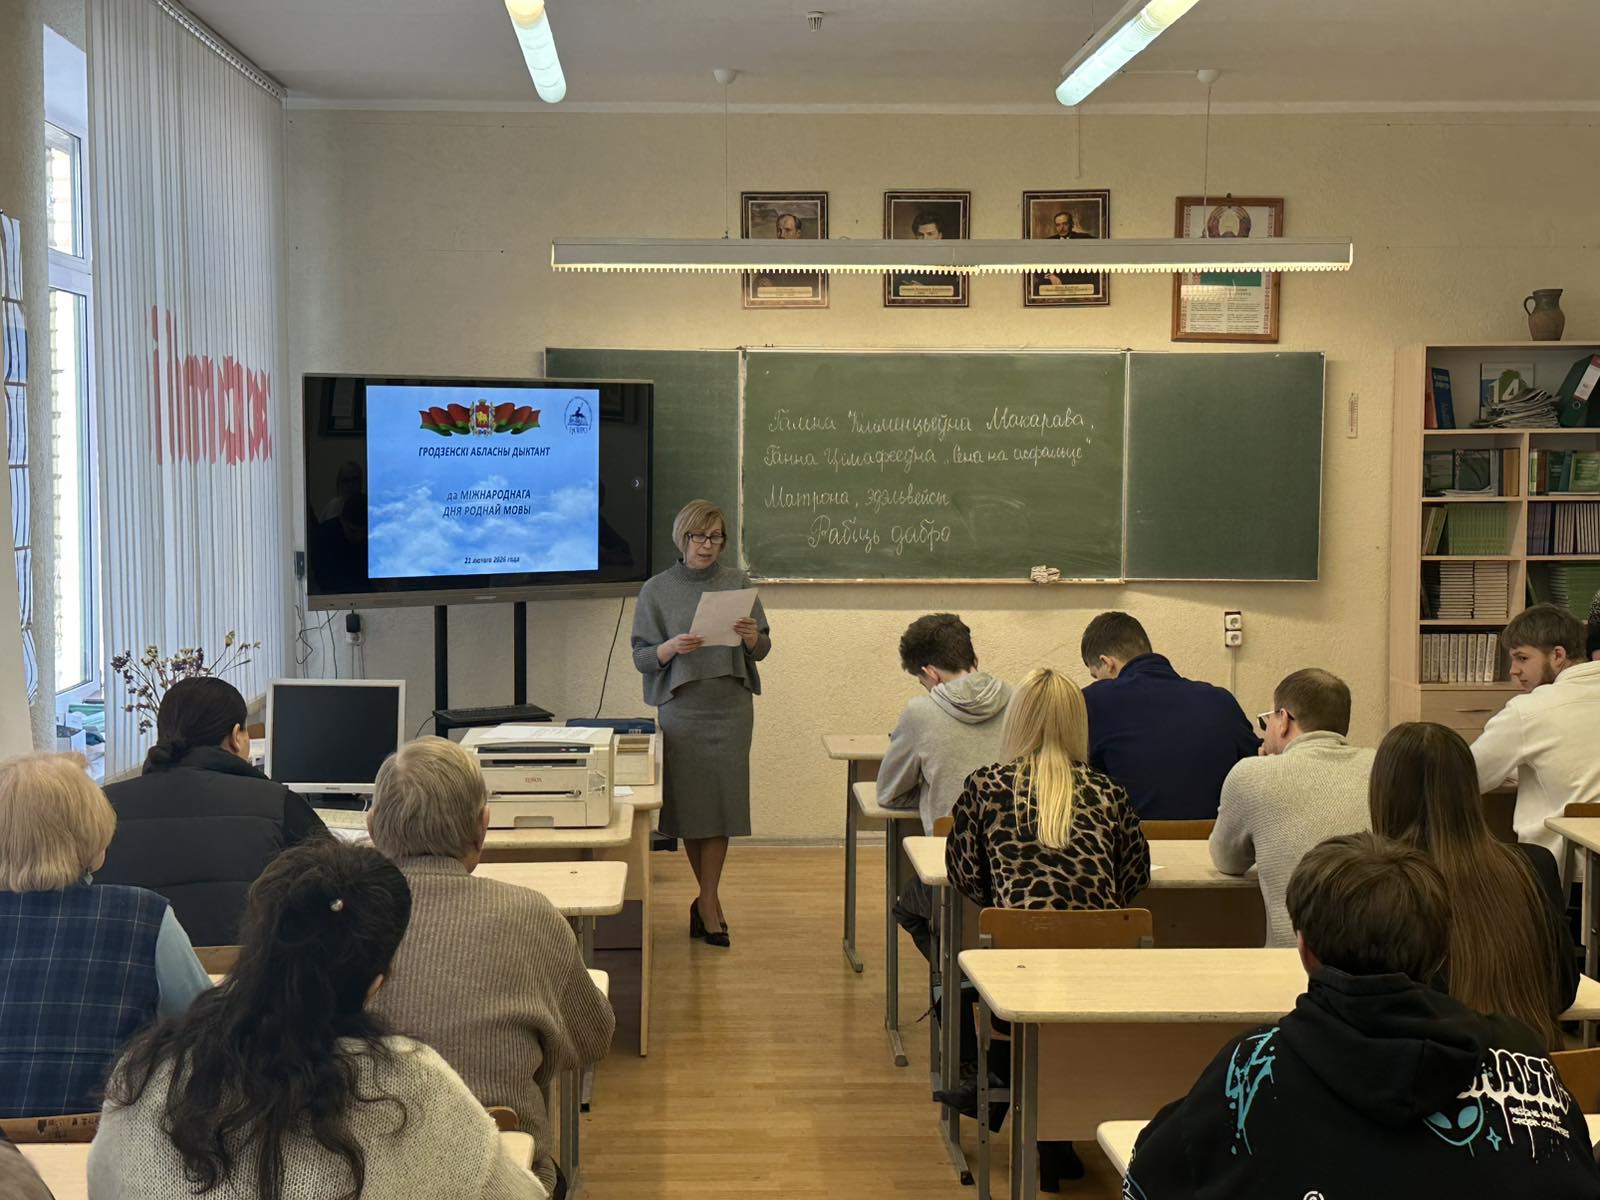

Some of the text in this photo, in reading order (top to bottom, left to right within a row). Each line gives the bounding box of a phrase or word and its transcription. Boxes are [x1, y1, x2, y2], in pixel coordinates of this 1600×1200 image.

[418, 446, 551, 458] ГРОДЗЕНСКІ АБЛАСНЫ ДЫКТАНТ
[988, 451, 1009, 462] на
[447, 489, 531, 501] да МІЖНАРОДНАГА
[442, 503, 531, 518] ДНЯ РОДНАЙ МОВЫ
[891, 519, 951, 556] дабро
